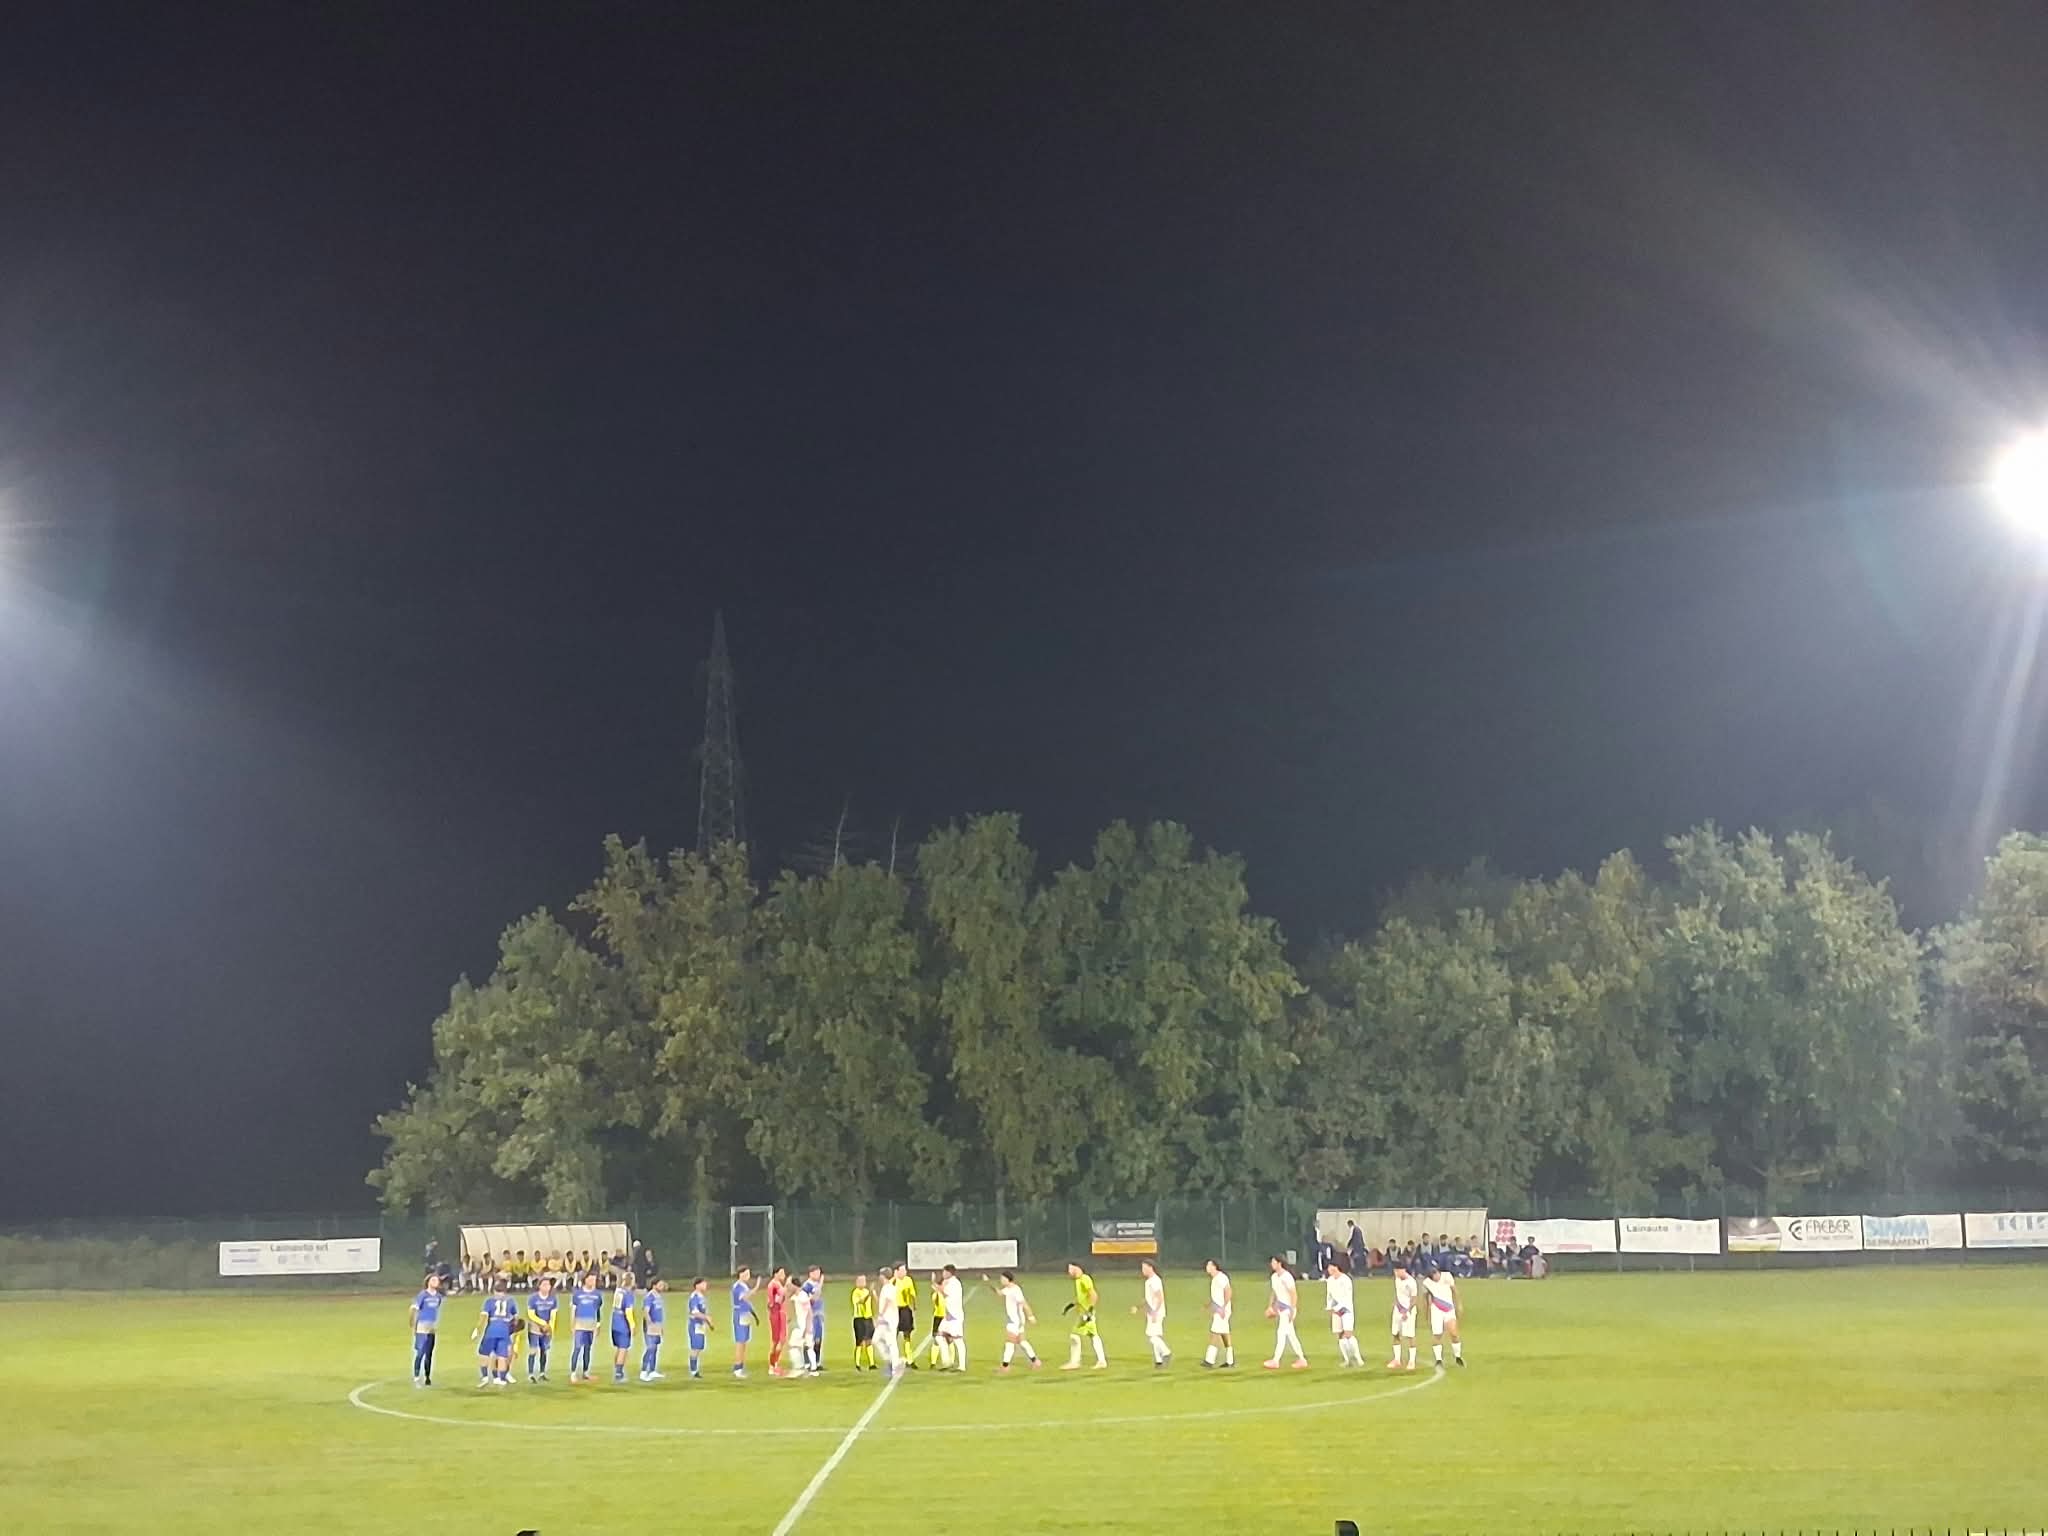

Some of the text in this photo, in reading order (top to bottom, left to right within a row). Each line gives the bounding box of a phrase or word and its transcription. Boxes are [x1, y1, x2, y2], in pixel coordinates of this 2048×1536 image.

[1626, 1223, 1669, 1232] Lainauto
[1806, 1218, 1853, 1234] FAEBER
[494, 1299, 507, 1317] 11
